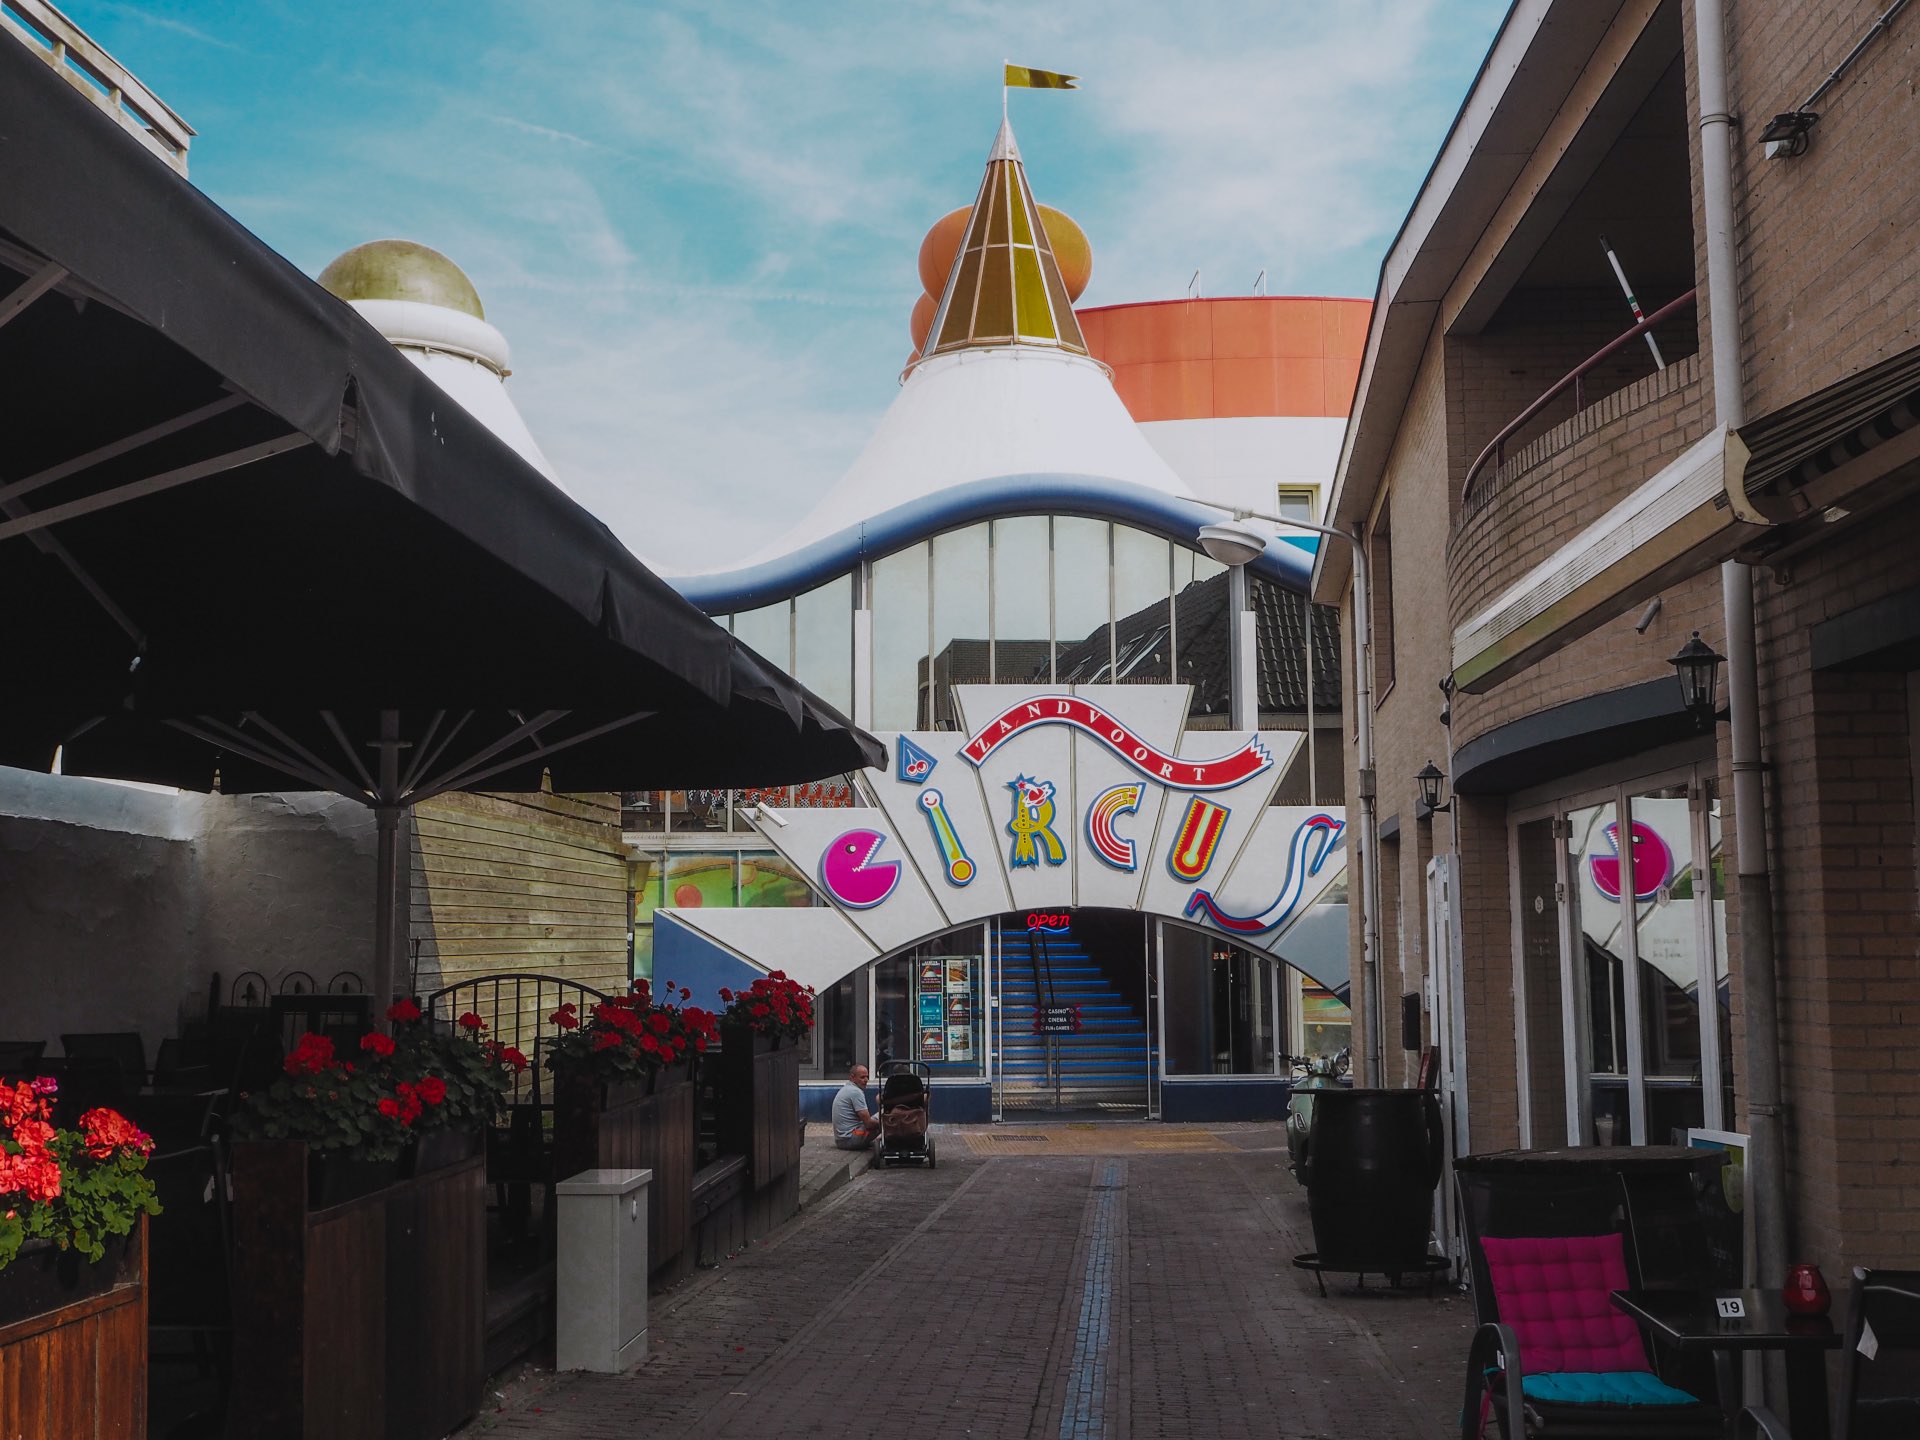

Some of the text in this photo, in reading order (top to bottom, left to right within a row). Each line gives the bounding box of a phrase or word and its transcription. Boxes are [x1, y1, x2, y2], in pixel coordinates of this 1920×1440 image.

[974, 700, 1206, 781] ZANDVOORT
[1027, 913, 1070, 931] Open
[1721, 1301, 1740, 1313] 19
